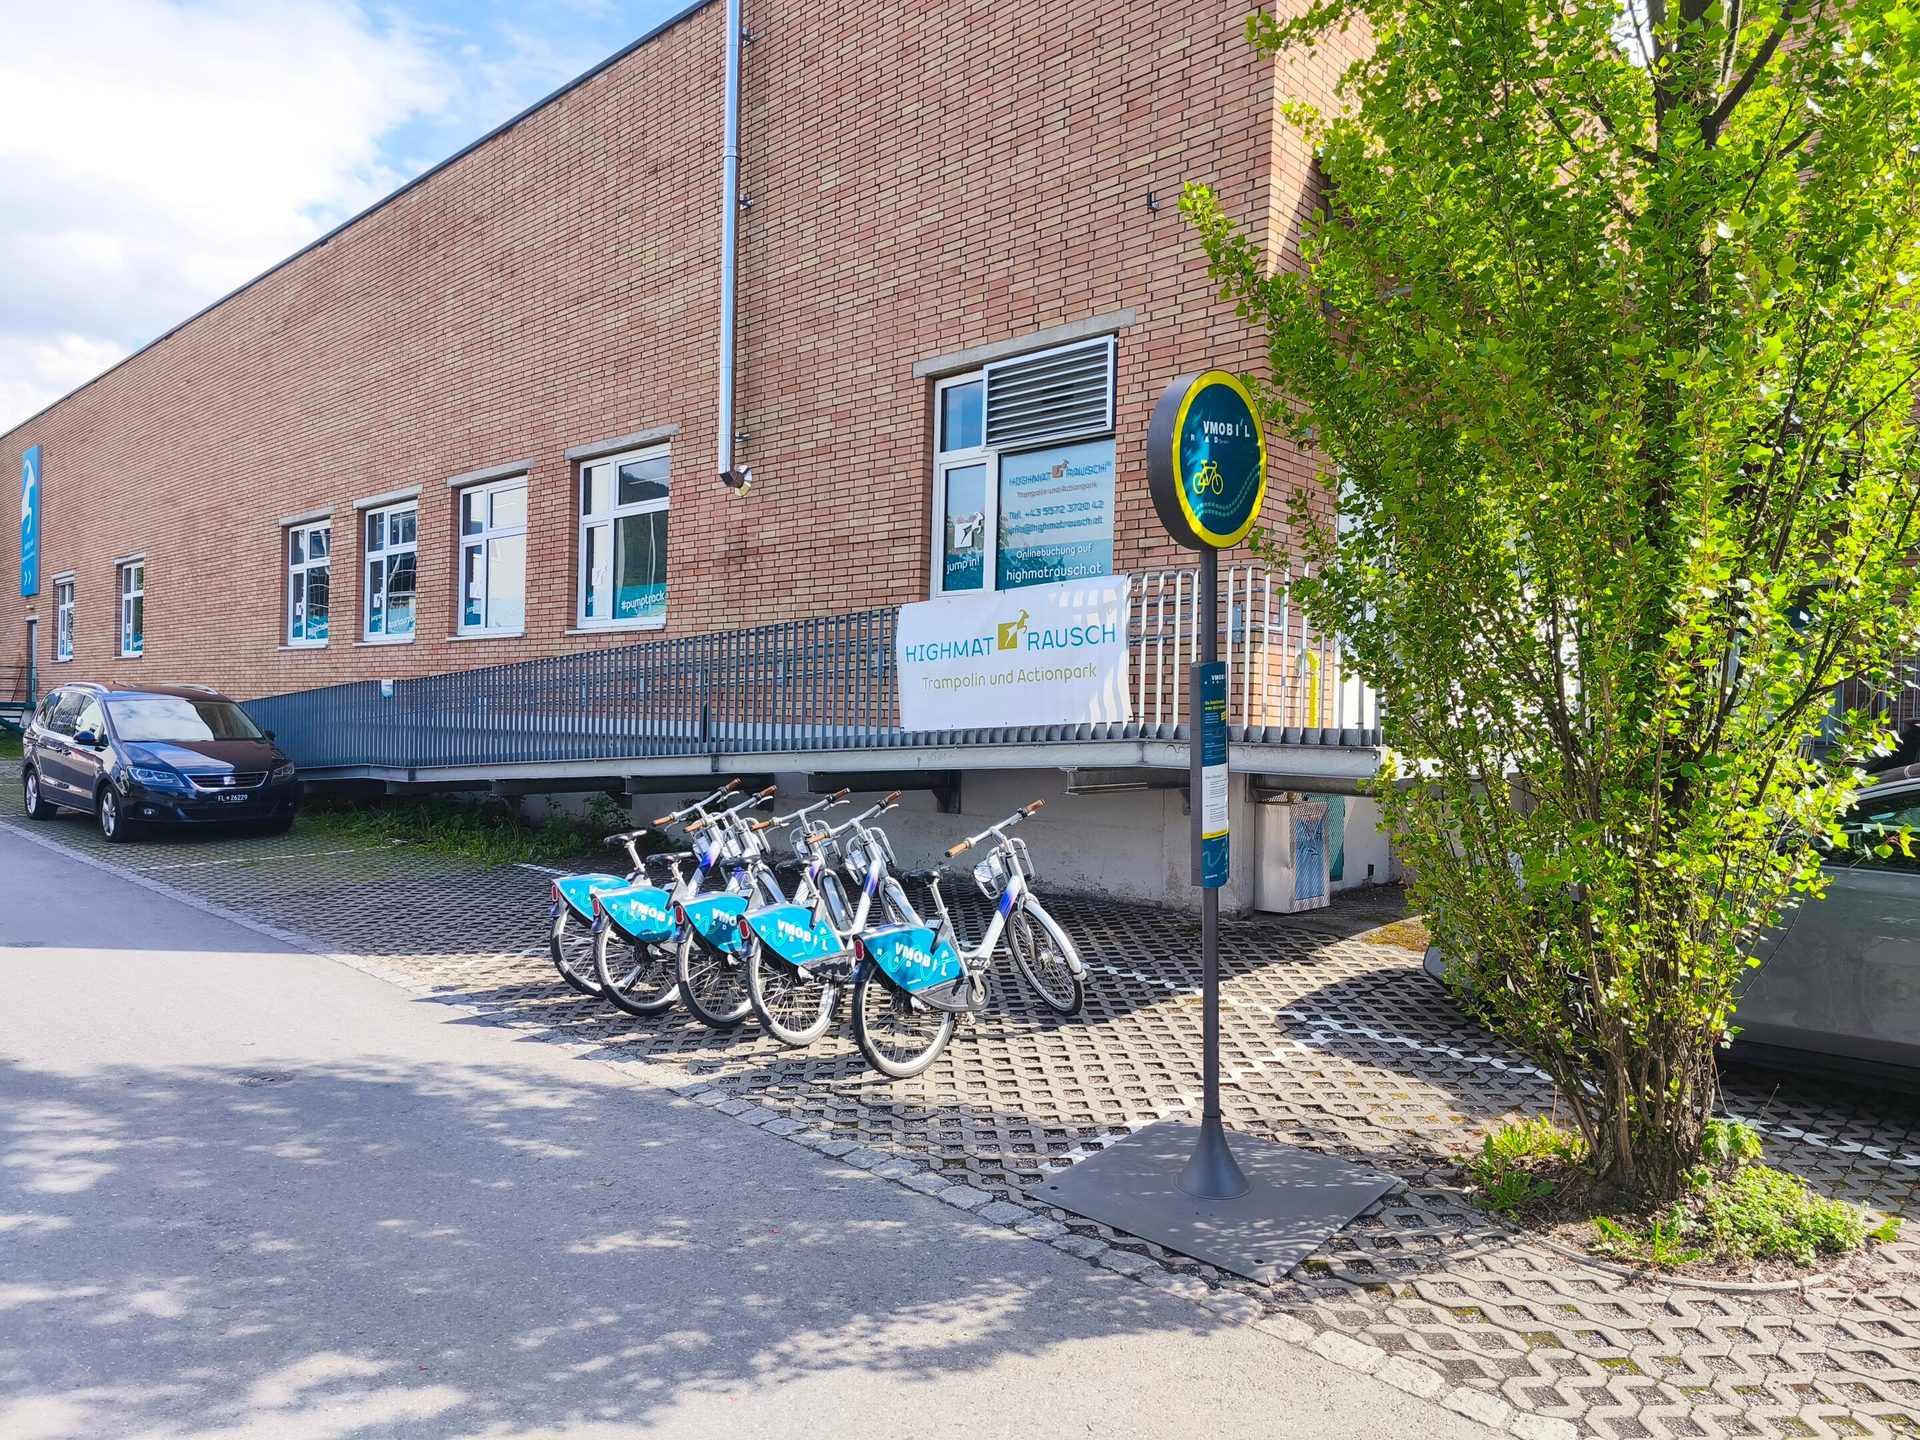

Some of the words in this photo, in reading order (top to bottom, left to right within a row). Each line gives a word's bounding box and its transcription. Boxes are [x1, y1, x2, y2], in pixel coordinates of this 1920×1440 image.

[1016, 545, 1076, 559] Onlinebuchung
[1077, 543, 1093, 554] auf
[946, 559, 967, 575] jump
[969, 558, 980, 568] in!
[1006, 562, 1102, 584] highmatrausch.at
[905, 636, 994, 663] HIGHMAT
[1027, 623, 1116, 651] RAUSCH
[922, 672, 986, 692] Trampolin
[990, 669, 1013, 685] und
[1018, 662, 1097, 684] Actionpark
[630, 899, 674, 925] VMOBI
